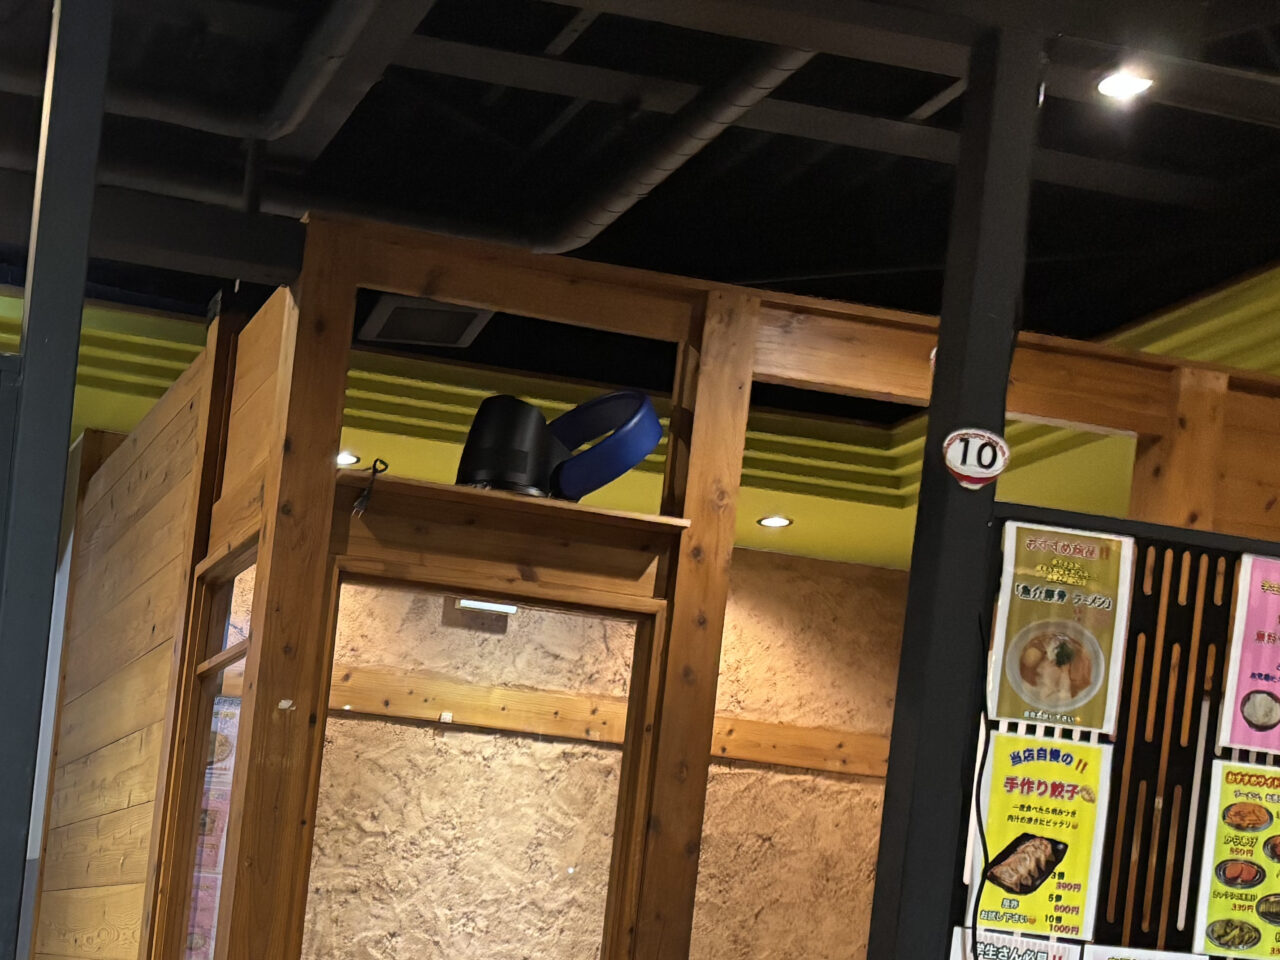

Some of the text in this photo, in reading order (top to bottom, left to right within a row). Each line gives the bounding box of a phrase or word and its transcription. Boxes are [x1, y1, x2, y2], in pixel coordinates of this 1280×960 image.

[959, 438, 998, 470] 10
[1004, 776, 1080, 800] 手作り餃子
